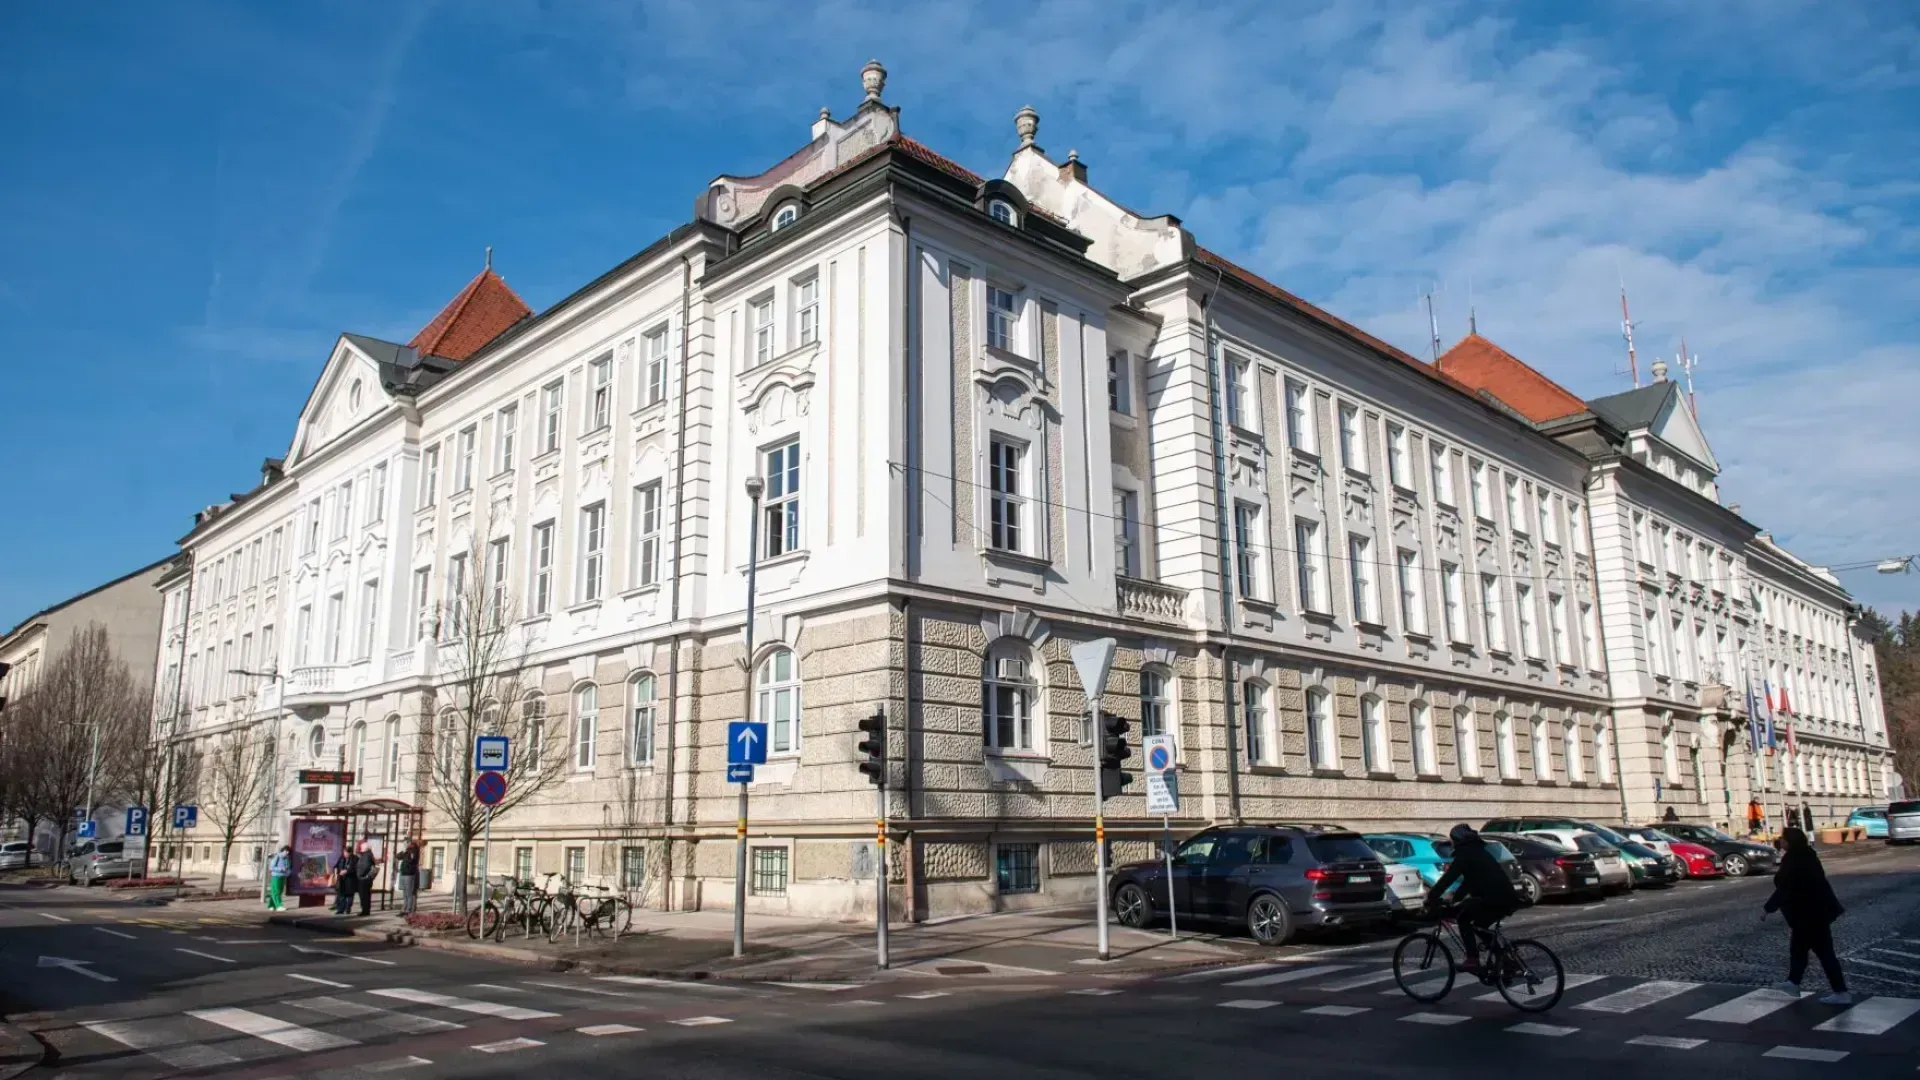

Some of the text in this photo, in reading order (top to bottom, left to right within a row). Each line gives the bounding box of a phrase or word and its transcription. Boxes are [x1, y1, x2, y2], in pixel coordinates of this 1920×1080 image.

[131, 809, 142, 822] P
[176, 808, 188, 824] P
[79, 822, 89, 834] P
